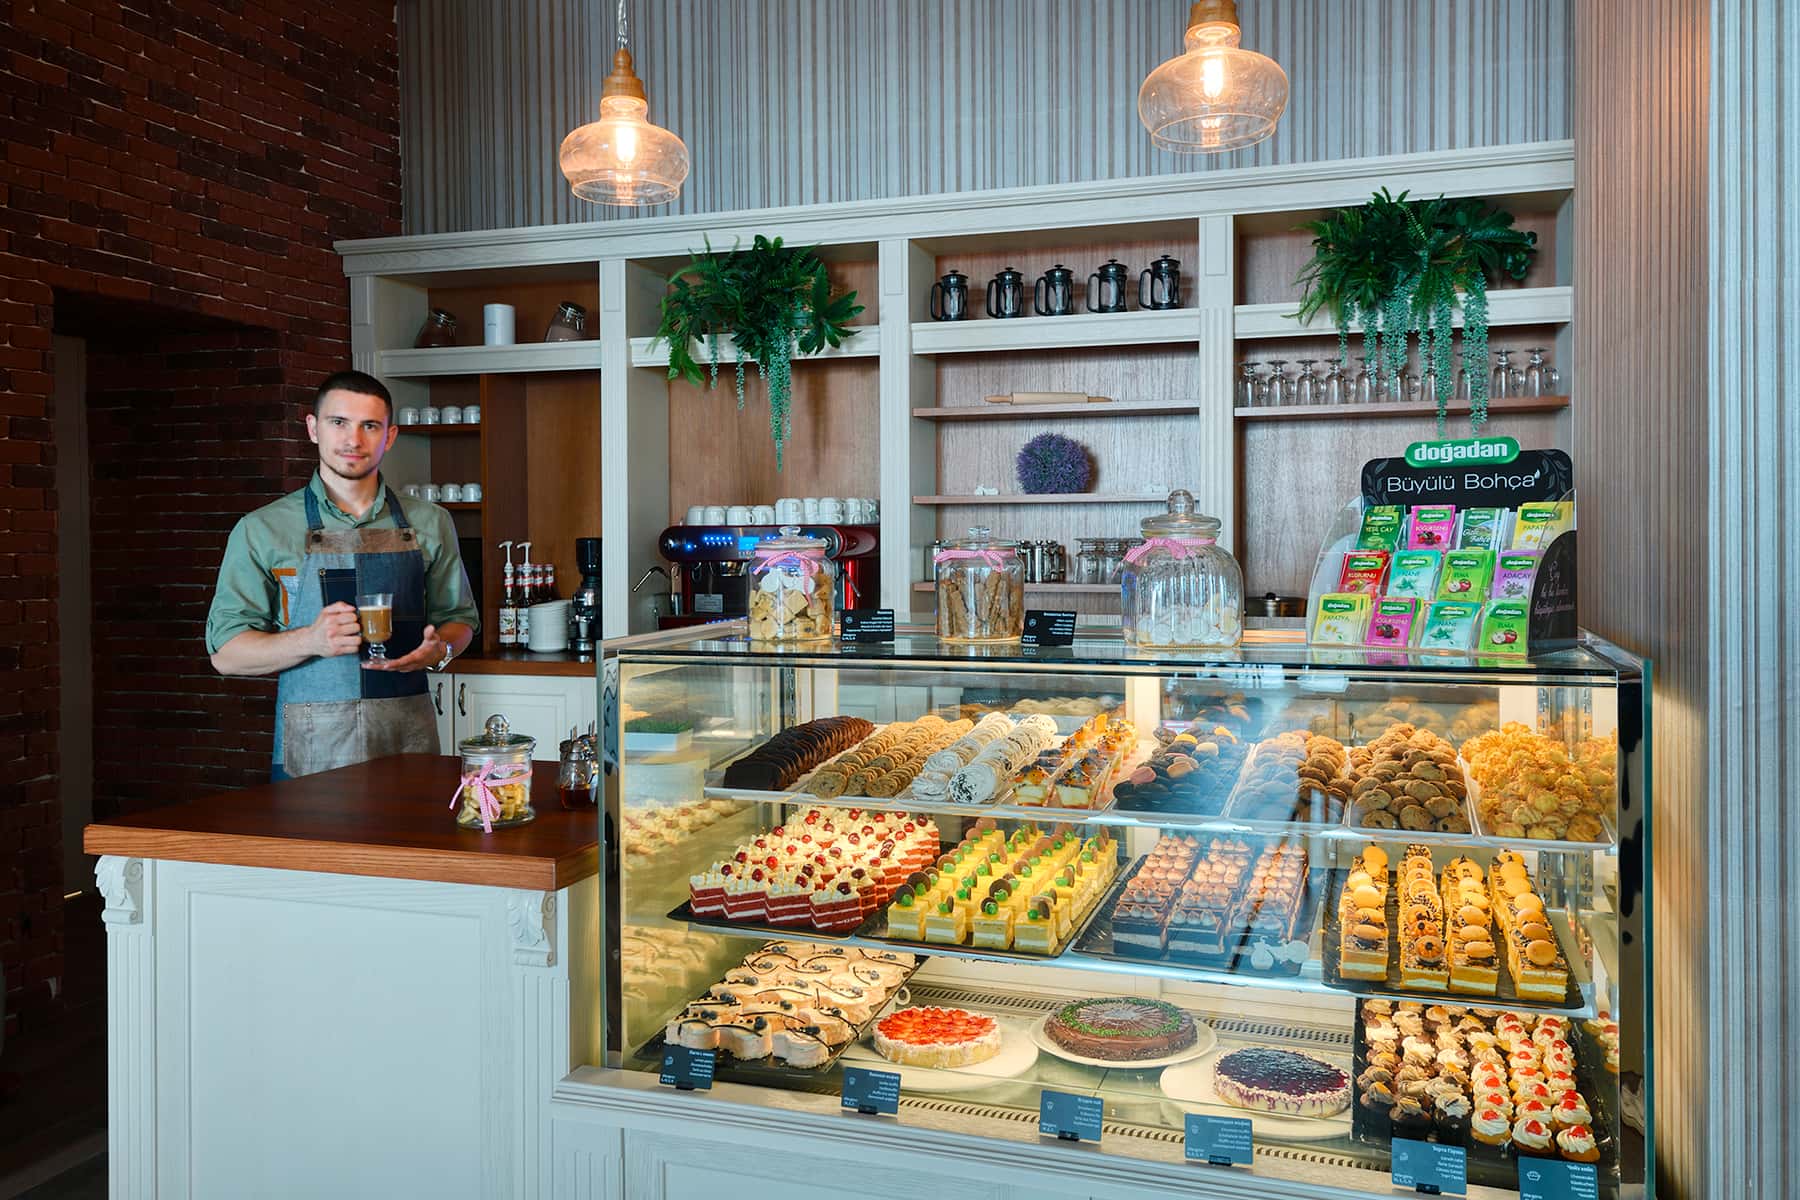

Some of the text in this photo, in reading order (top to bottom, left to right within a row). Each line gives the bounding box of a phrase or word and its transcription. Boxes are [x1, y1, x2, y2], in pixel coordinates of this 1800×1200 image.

[1414, 440, 1507, 463] doğadan
[1387, 472, 1535, 494] Büyülü Bohça
